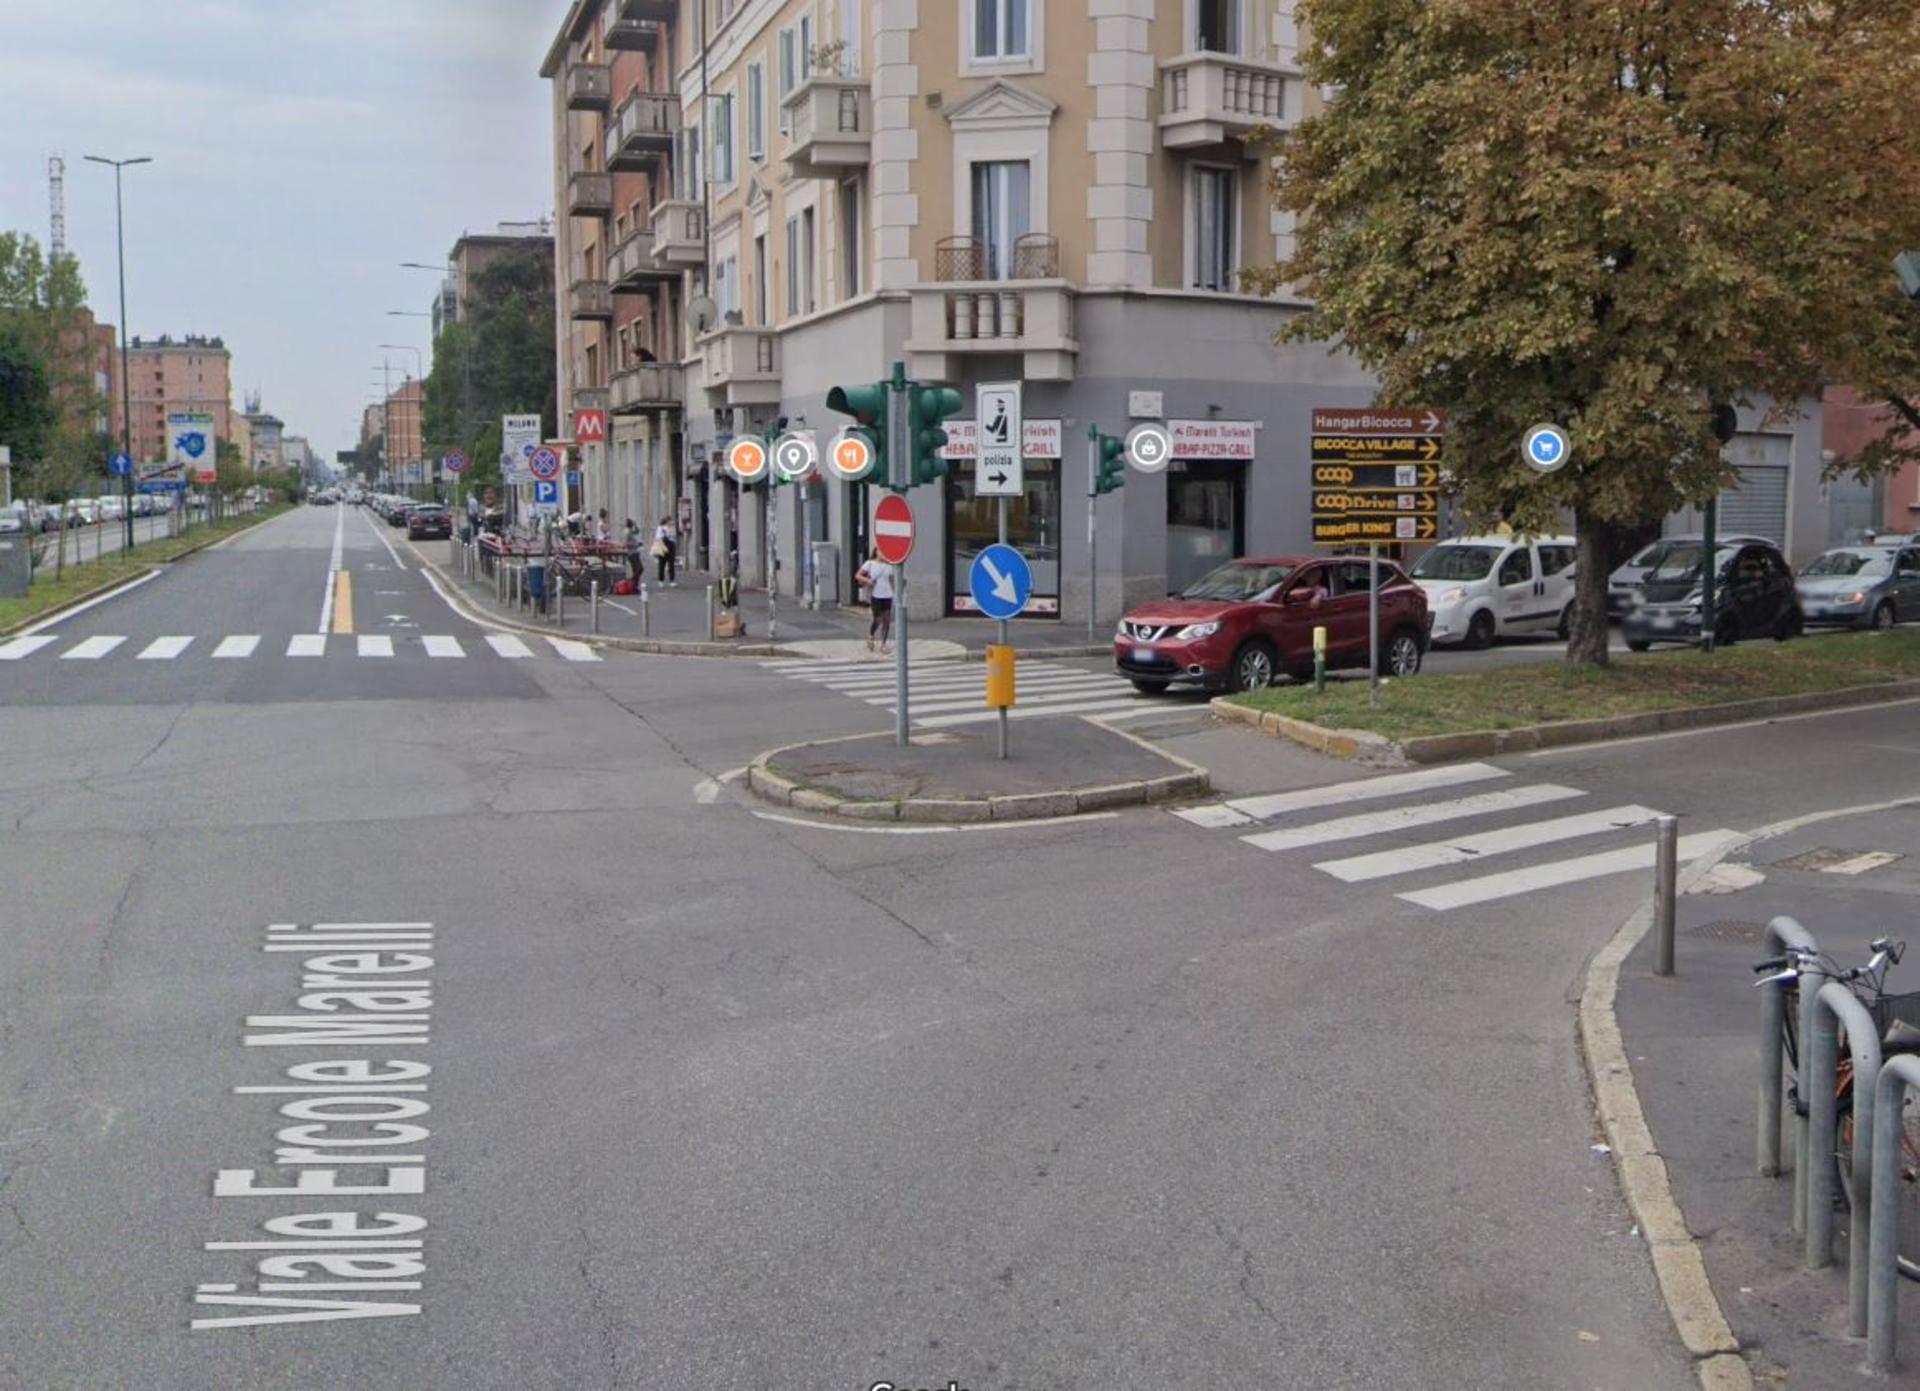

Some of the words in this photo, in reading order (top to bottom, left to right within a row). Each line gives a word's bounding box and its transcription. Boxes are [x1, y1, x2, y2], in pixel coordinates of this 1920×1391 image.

[577, 415, 603, 435] M
[1315, 415, 1412, 429] HangarBicocca
[1314, 439, 1366, 450] BICOCCA
[1365, 439, 1416, 450] VILLAGE
[984, 454, 1013, 467] polizia
[1316, 467, 1353, 484] coop
[538, 481, 554, 501] P
[1316, 522, 1360, 536] BURGER
[1361, 522, 1392, 534] KING
